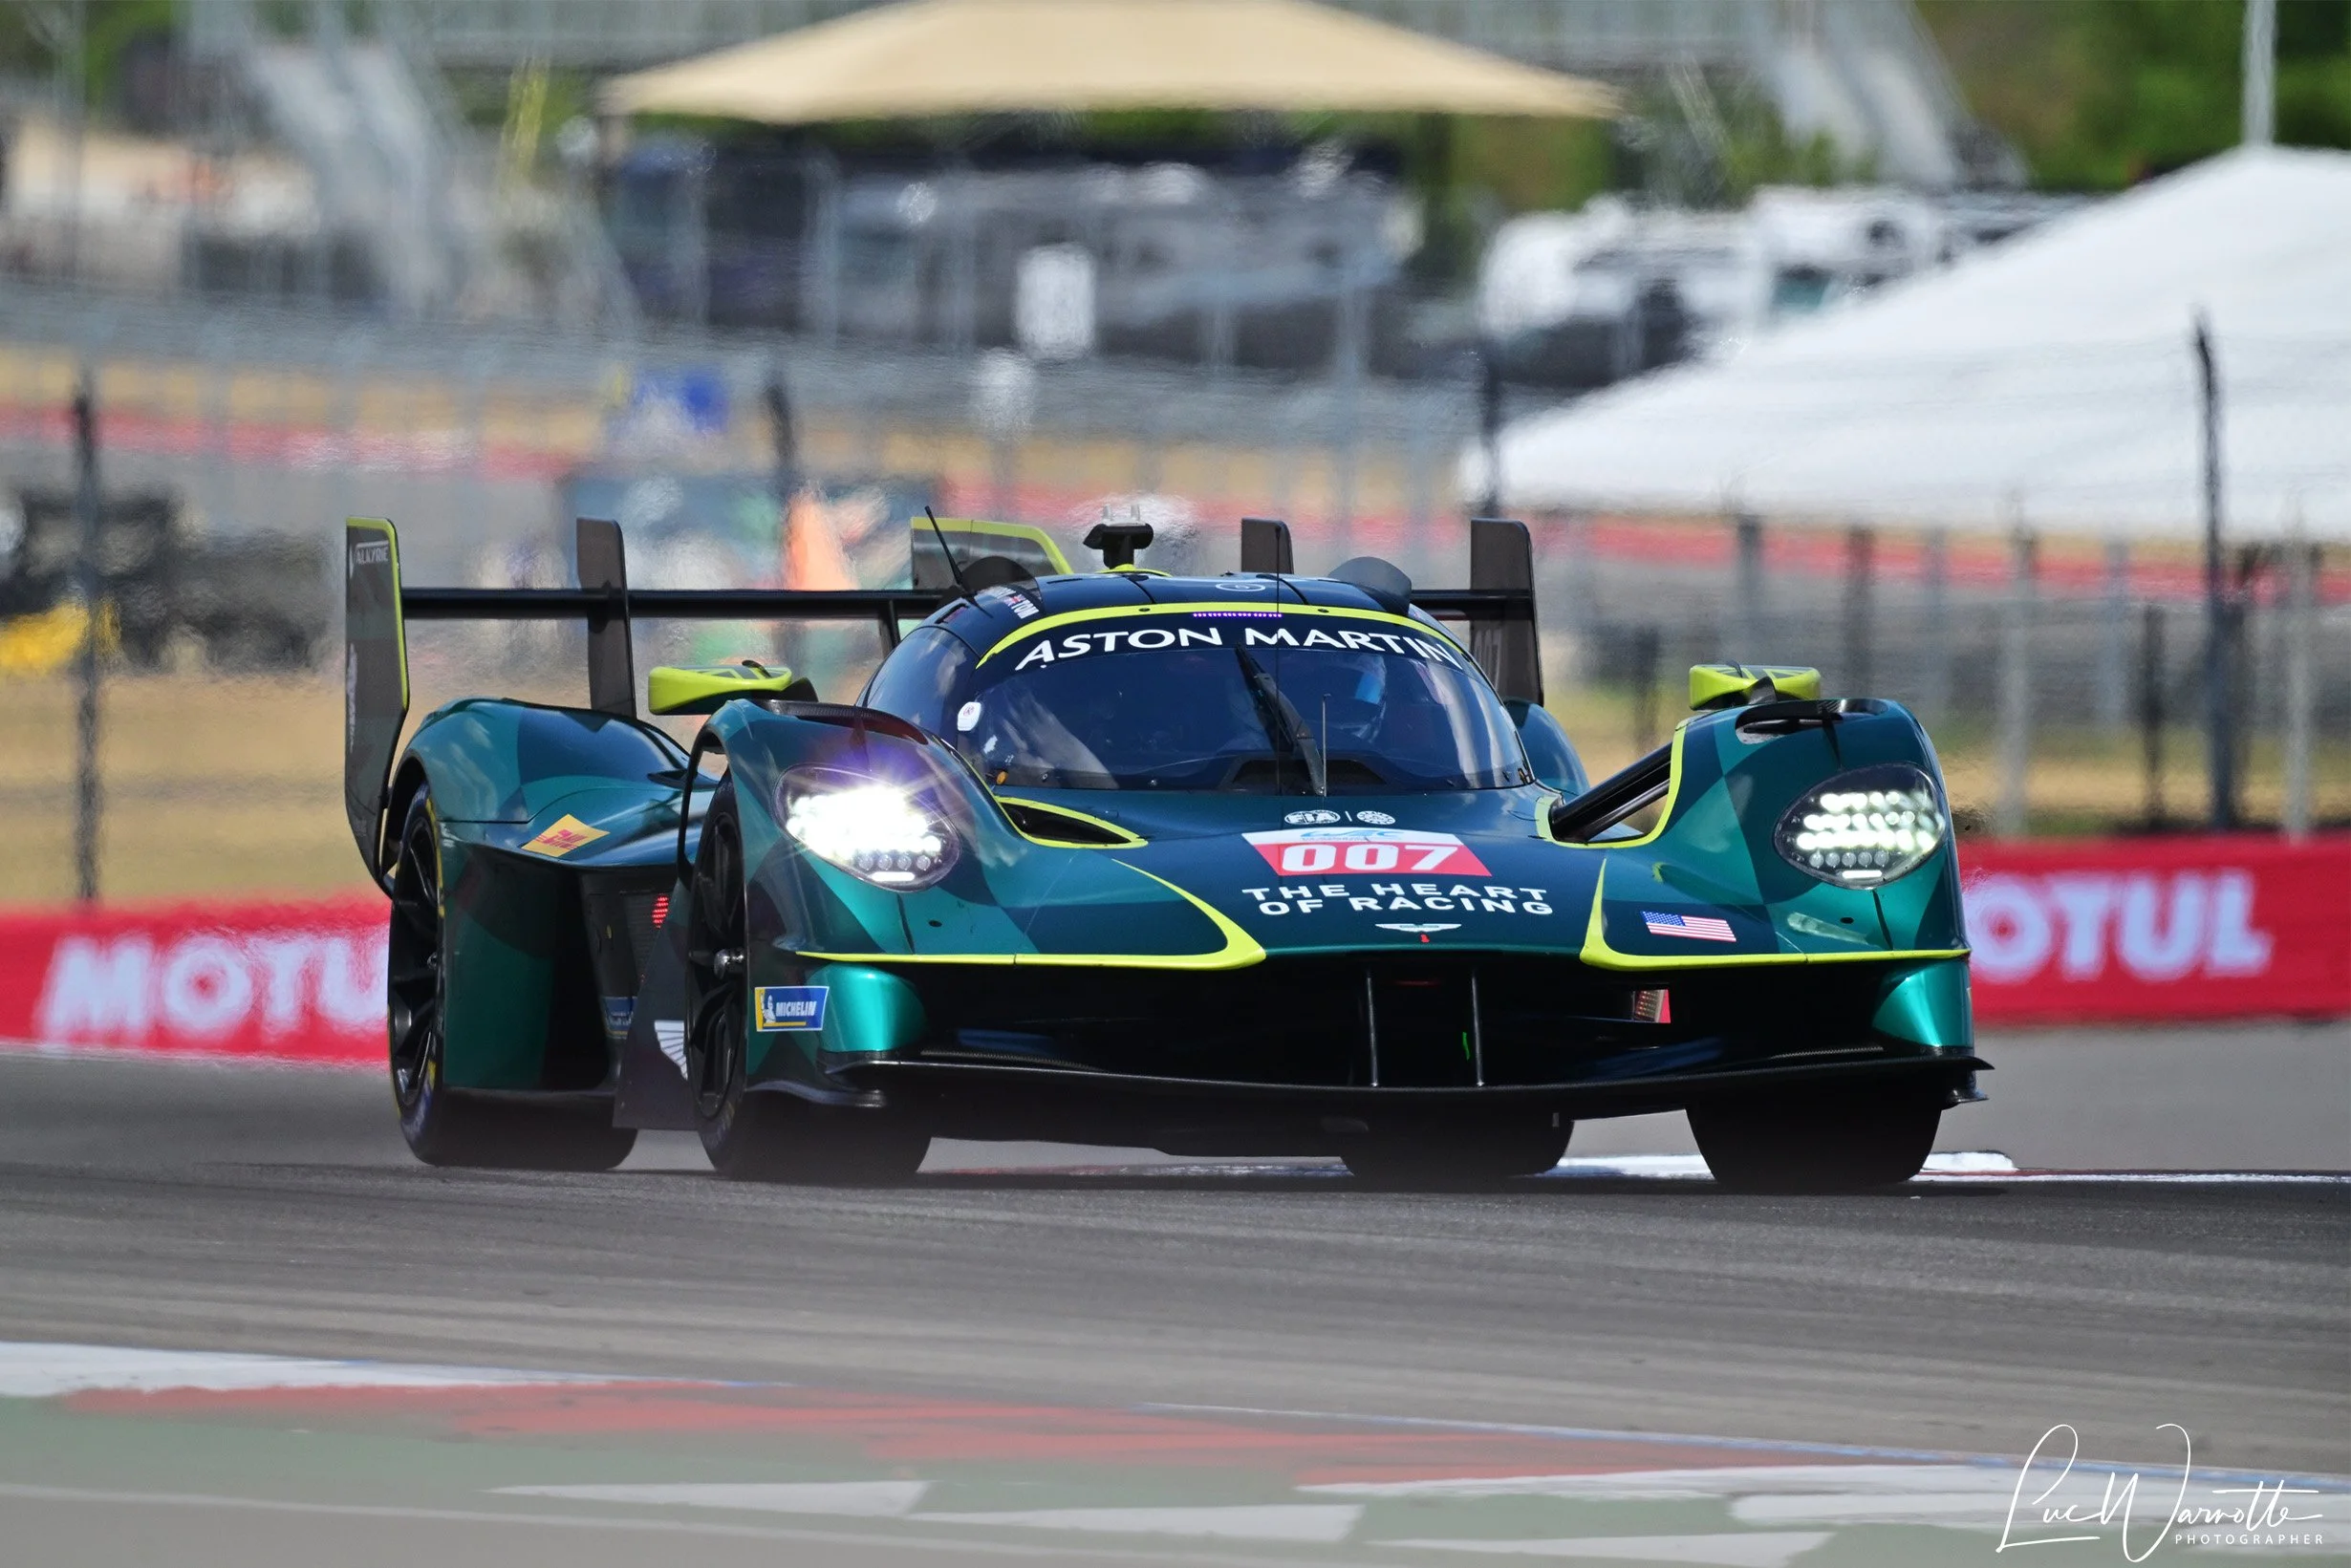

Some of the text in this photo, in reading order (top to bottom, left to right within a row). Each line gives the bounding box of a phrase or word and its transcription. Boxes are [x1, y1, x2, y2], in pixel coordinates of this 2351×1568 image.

[1015, 628, 1463, 671] ASTON MARTIN
[1290, 813, 1336, 825] FIA
[1282, 844, 1458, 871] 007
[1242, 883, 1548, 901] THE HEART
[1259, 896, 1553, 915] OF RACING
[1960, 871, 2273, 984] OTUL
[46, 927, 389, 1042] MOTU
[776, 1001, 816, 1016] MICHELIN
